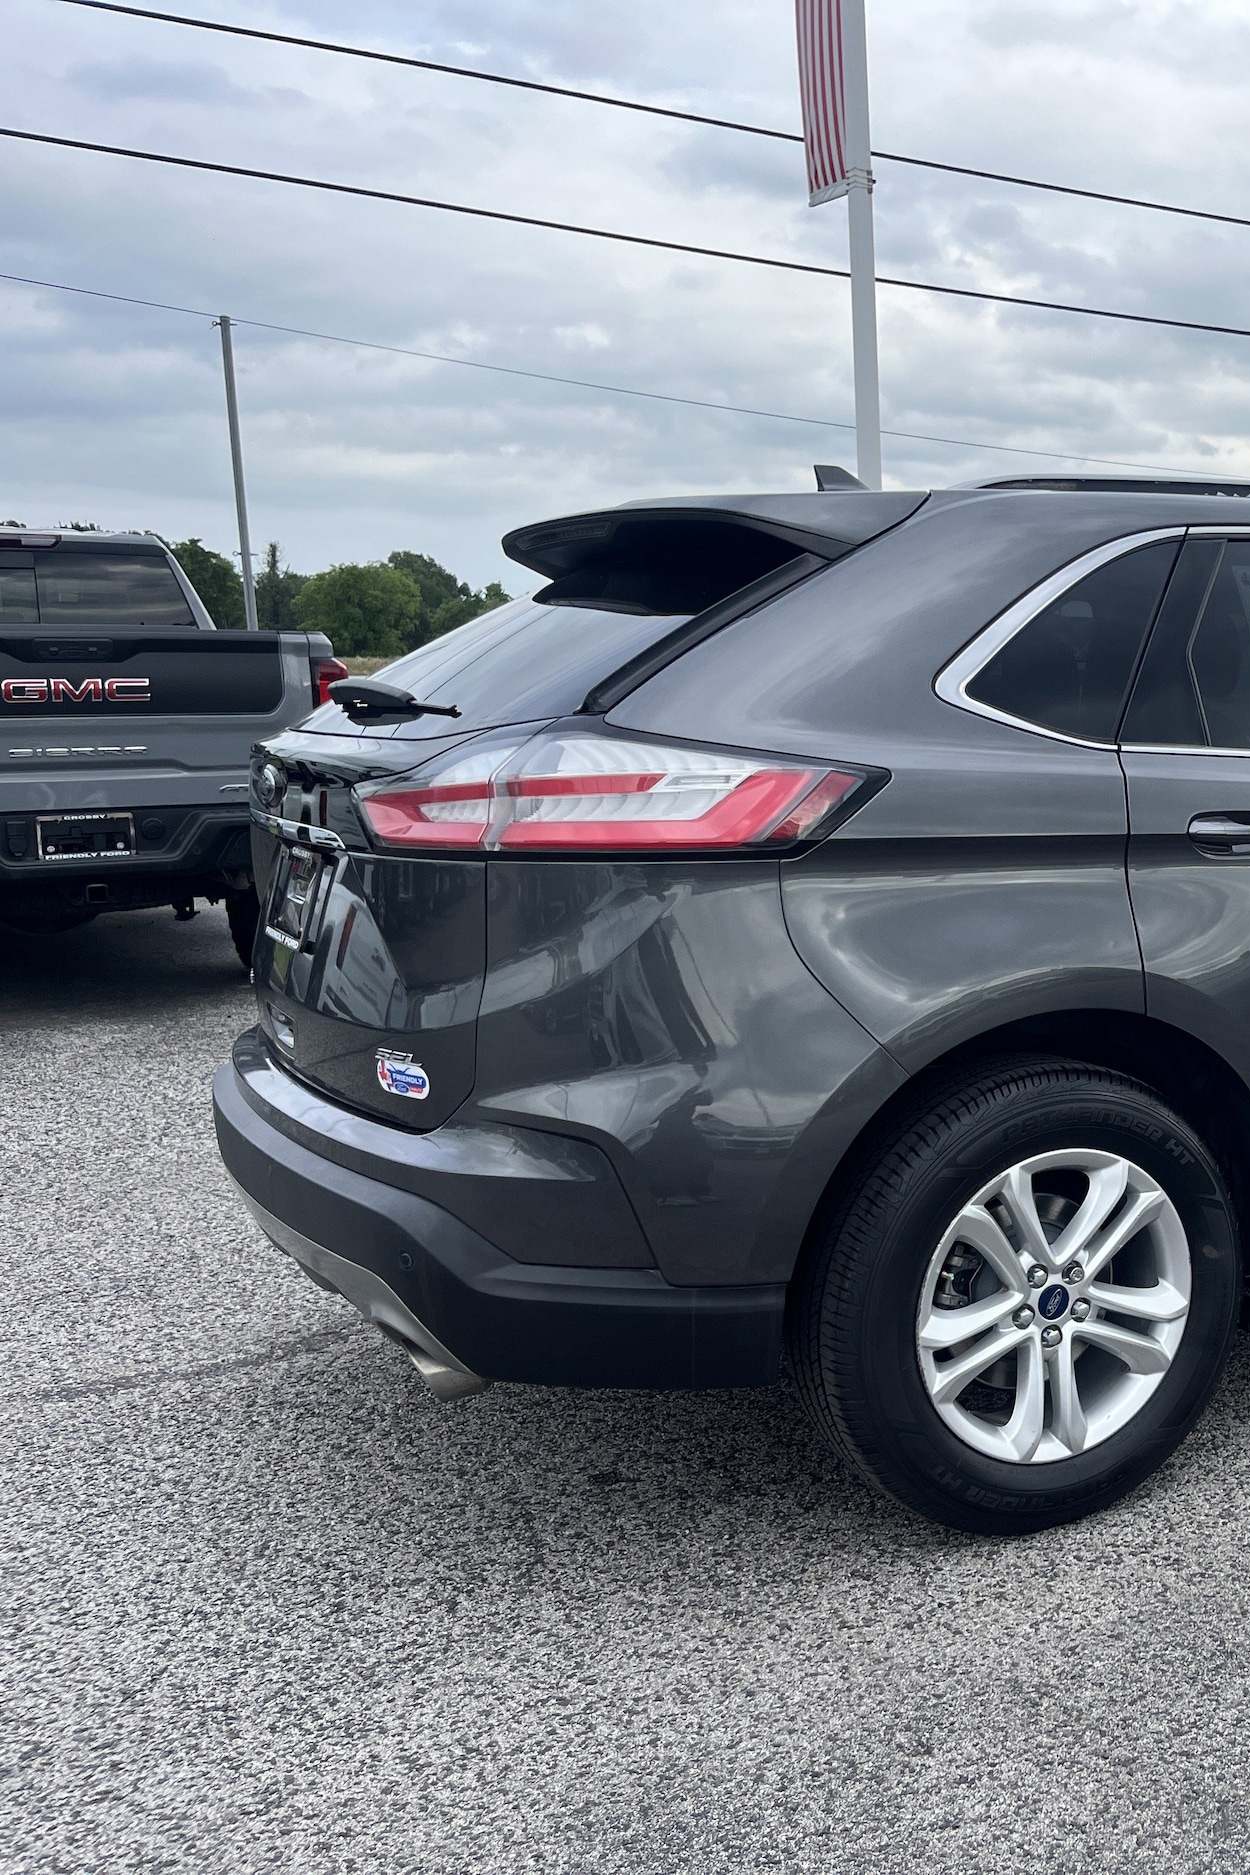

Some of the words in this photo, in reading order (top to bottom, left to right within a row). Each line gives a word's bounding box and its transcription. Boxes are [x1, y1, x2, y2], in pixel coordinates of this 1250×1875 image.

[1, 678, 151, 703] GMC
[8, 745, 148, 758] SIERRA
[45, 851, 98, 861] FRIENDLY
[285, 935, 299, 950] FORD
[393, 1073, 423, 1085] FRIENDLY
[1000, 1105, 1163, 1145] PATHFINDER
[1164, 1137, 1196, 1166] HT
